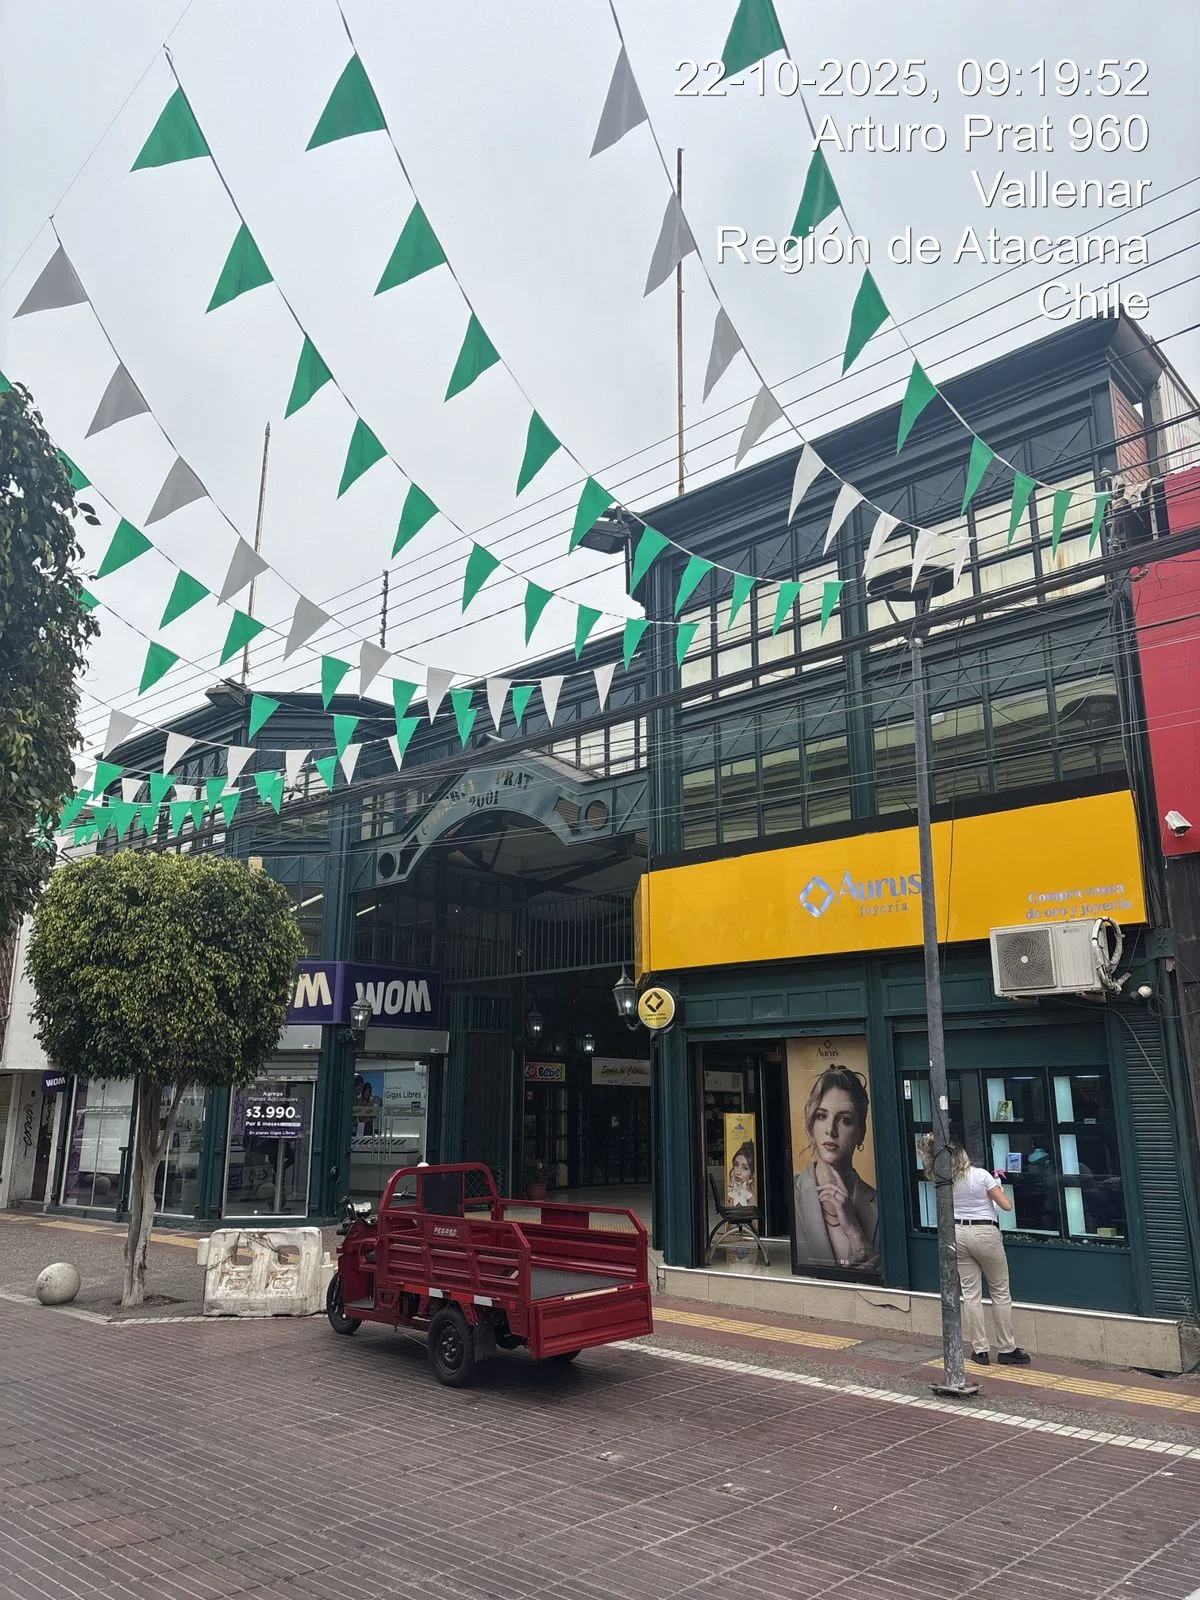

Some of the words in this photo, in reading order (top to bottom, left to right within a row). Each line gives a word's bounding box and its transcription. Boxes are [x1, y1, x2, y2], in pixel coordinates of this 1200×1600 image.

[836, 868, 922, 904] Aurus
[1027, 887, 1082, 904] Compra
[1085, 883, 1125, 897] venta
[1025, 908, 1042, 920] de
[1045, 906, 1068, 918] oro
[1070, 905, 1078, 918] y
[355, 980, 432, 1016] WOM
[816, 1047, 839, 1057] Aurus
[45, 1077, 66, 1087] WOM
[385, 1091, 402, 1101] Gigas
[403, 1090, 422, 1099] Libres
[246, 1105, 296, 1119] $3.990
